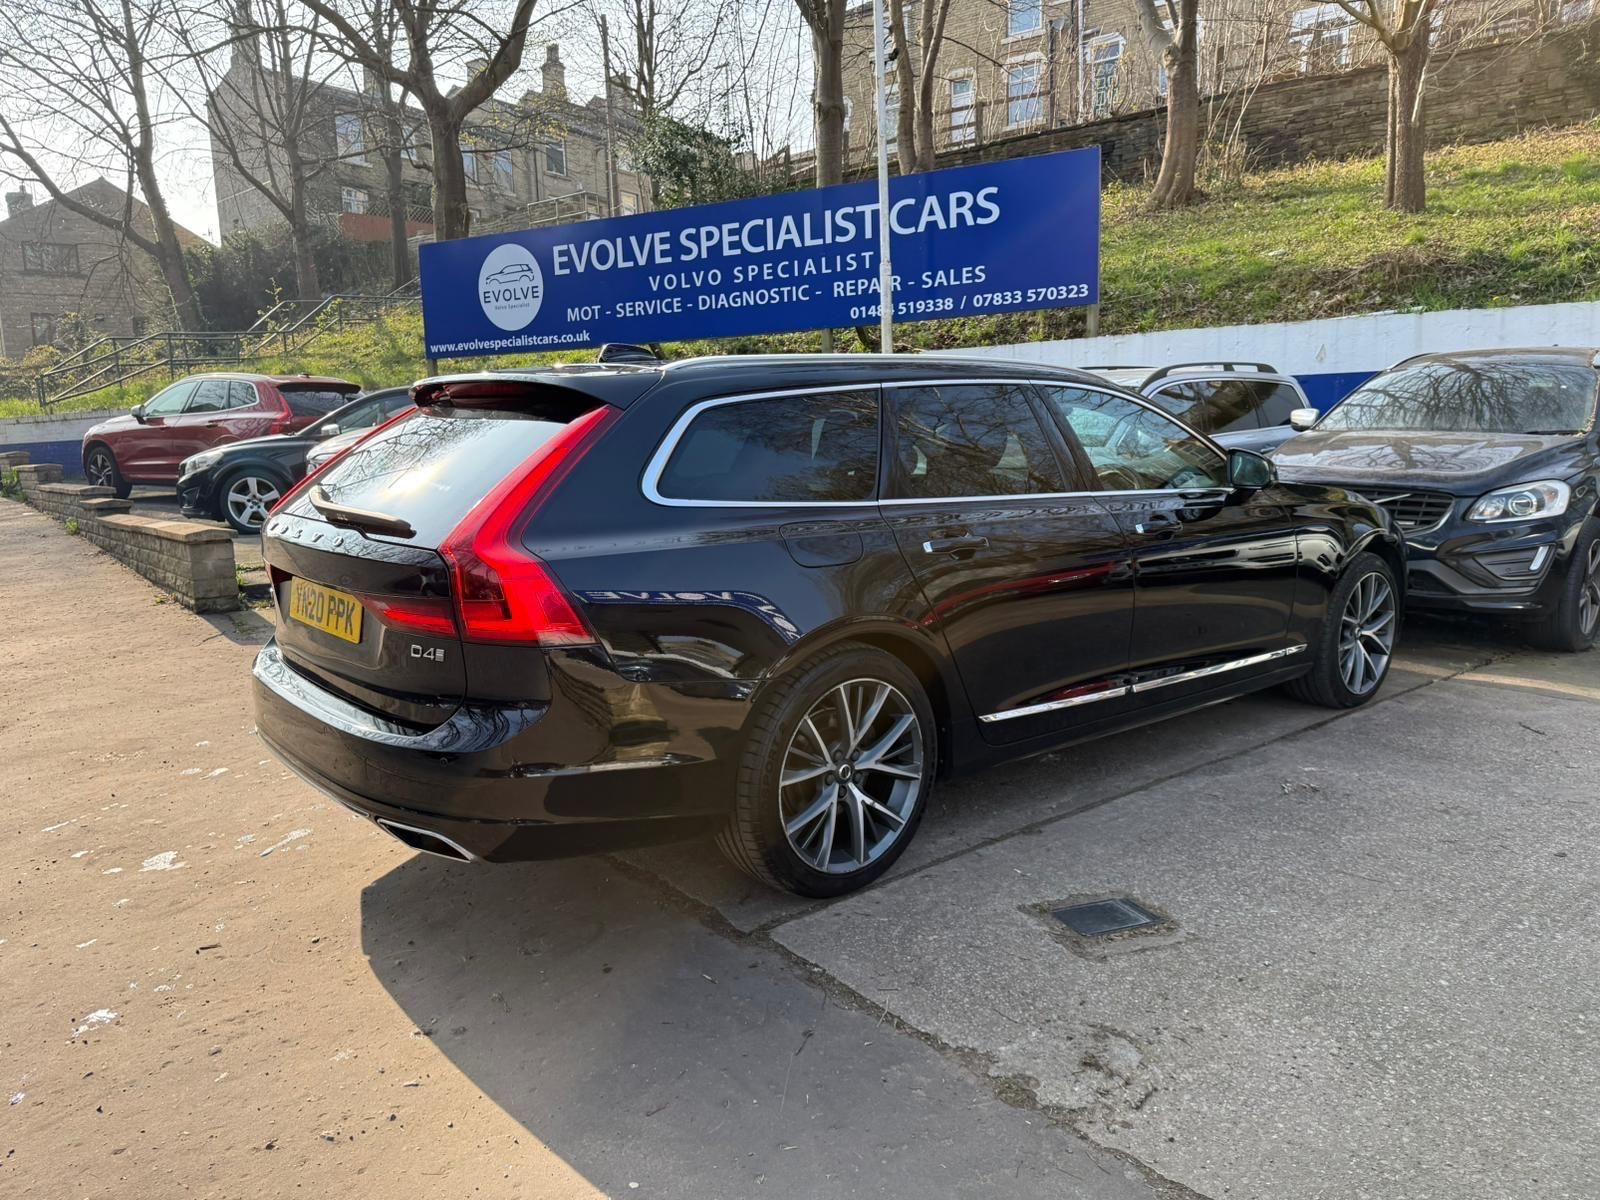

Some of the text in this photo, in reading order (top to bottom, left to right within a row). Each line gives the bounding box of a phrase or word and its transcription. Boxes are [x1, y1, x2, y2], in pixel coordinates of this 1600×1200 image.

[553, 186, 1000, 275] EVOLVE SPECIALIST CARS
[648, 251, 874, 291] VOLVO SPECIALIST
[483, 285, 540, 304] EVOLVE
[508, 302, 530, 310] Specialist
[567, 305, 601, 322] MOT
[616, 297, 682, 318] SERVICE
[698, 284, 810, 311] DIAGNOSTIC
[834, 275, 901, 298] REPAR
[921, 265, 986, 289] SALES
[898, 298, 954, 315] 519338
[972, 290, 1022, 308] 07833
[1026, 284, 1089, 302] 570323
[430, 330, 591, 353] www.evolvespecialistcars.co.uk
[326, 594, 356, 636] PPK
